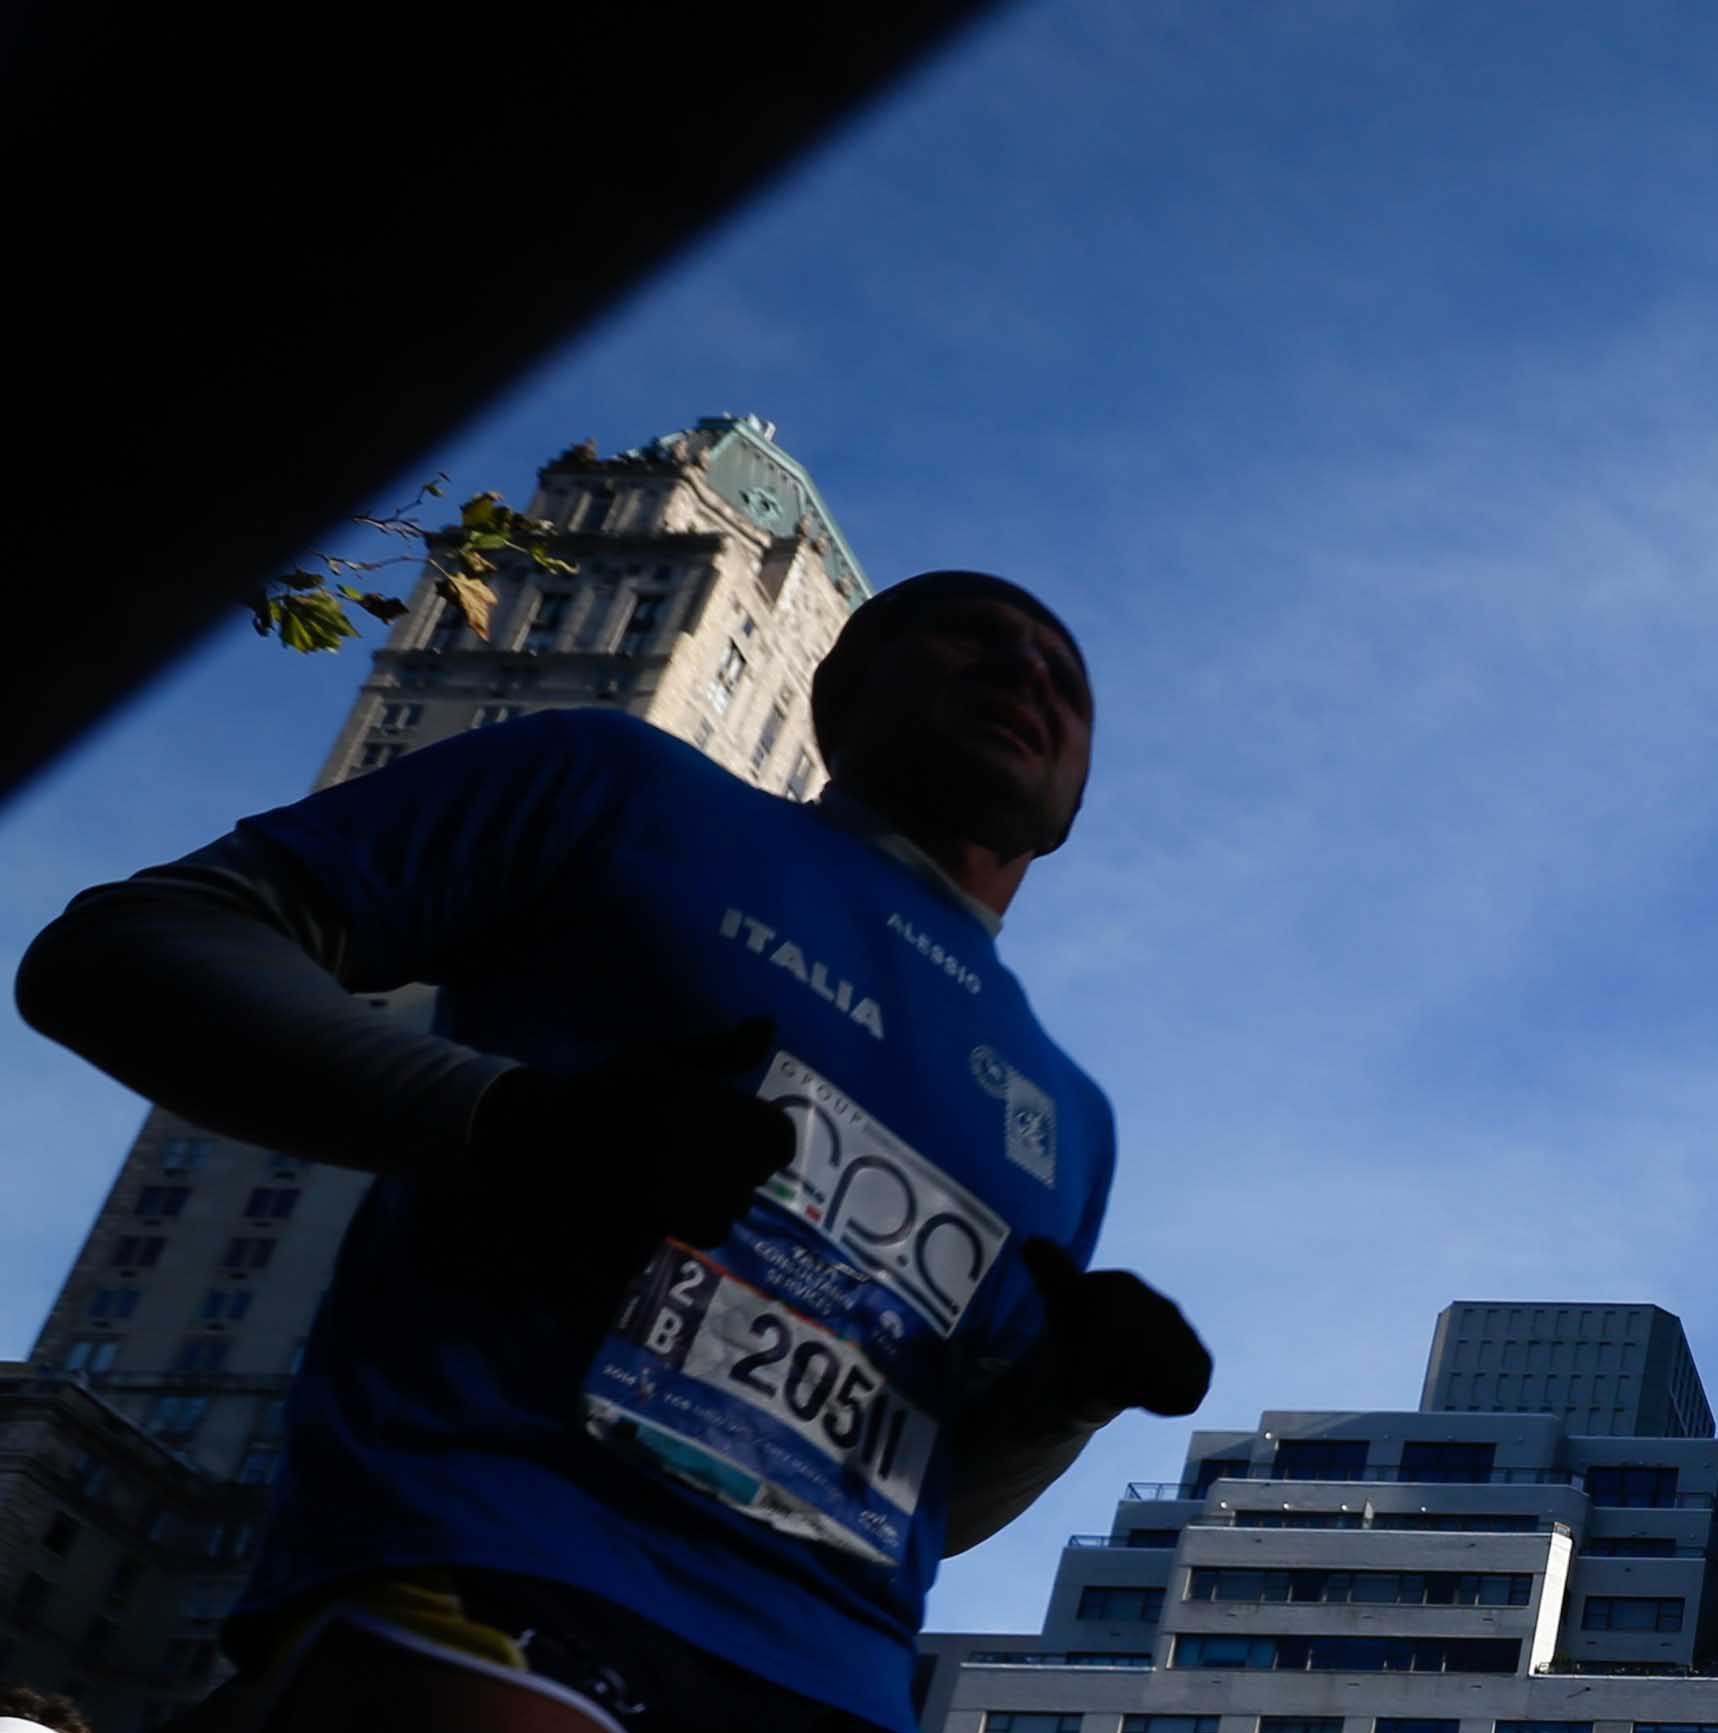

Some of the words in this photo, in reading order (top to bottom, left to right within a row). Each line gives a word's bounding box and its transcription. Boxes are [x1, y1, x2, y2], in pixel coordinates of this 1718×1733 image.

[719, 906, 886, 1041] ITALIA
[668, 1260, 705, 1307] 2
[644, 1305, 684, 1356] B
